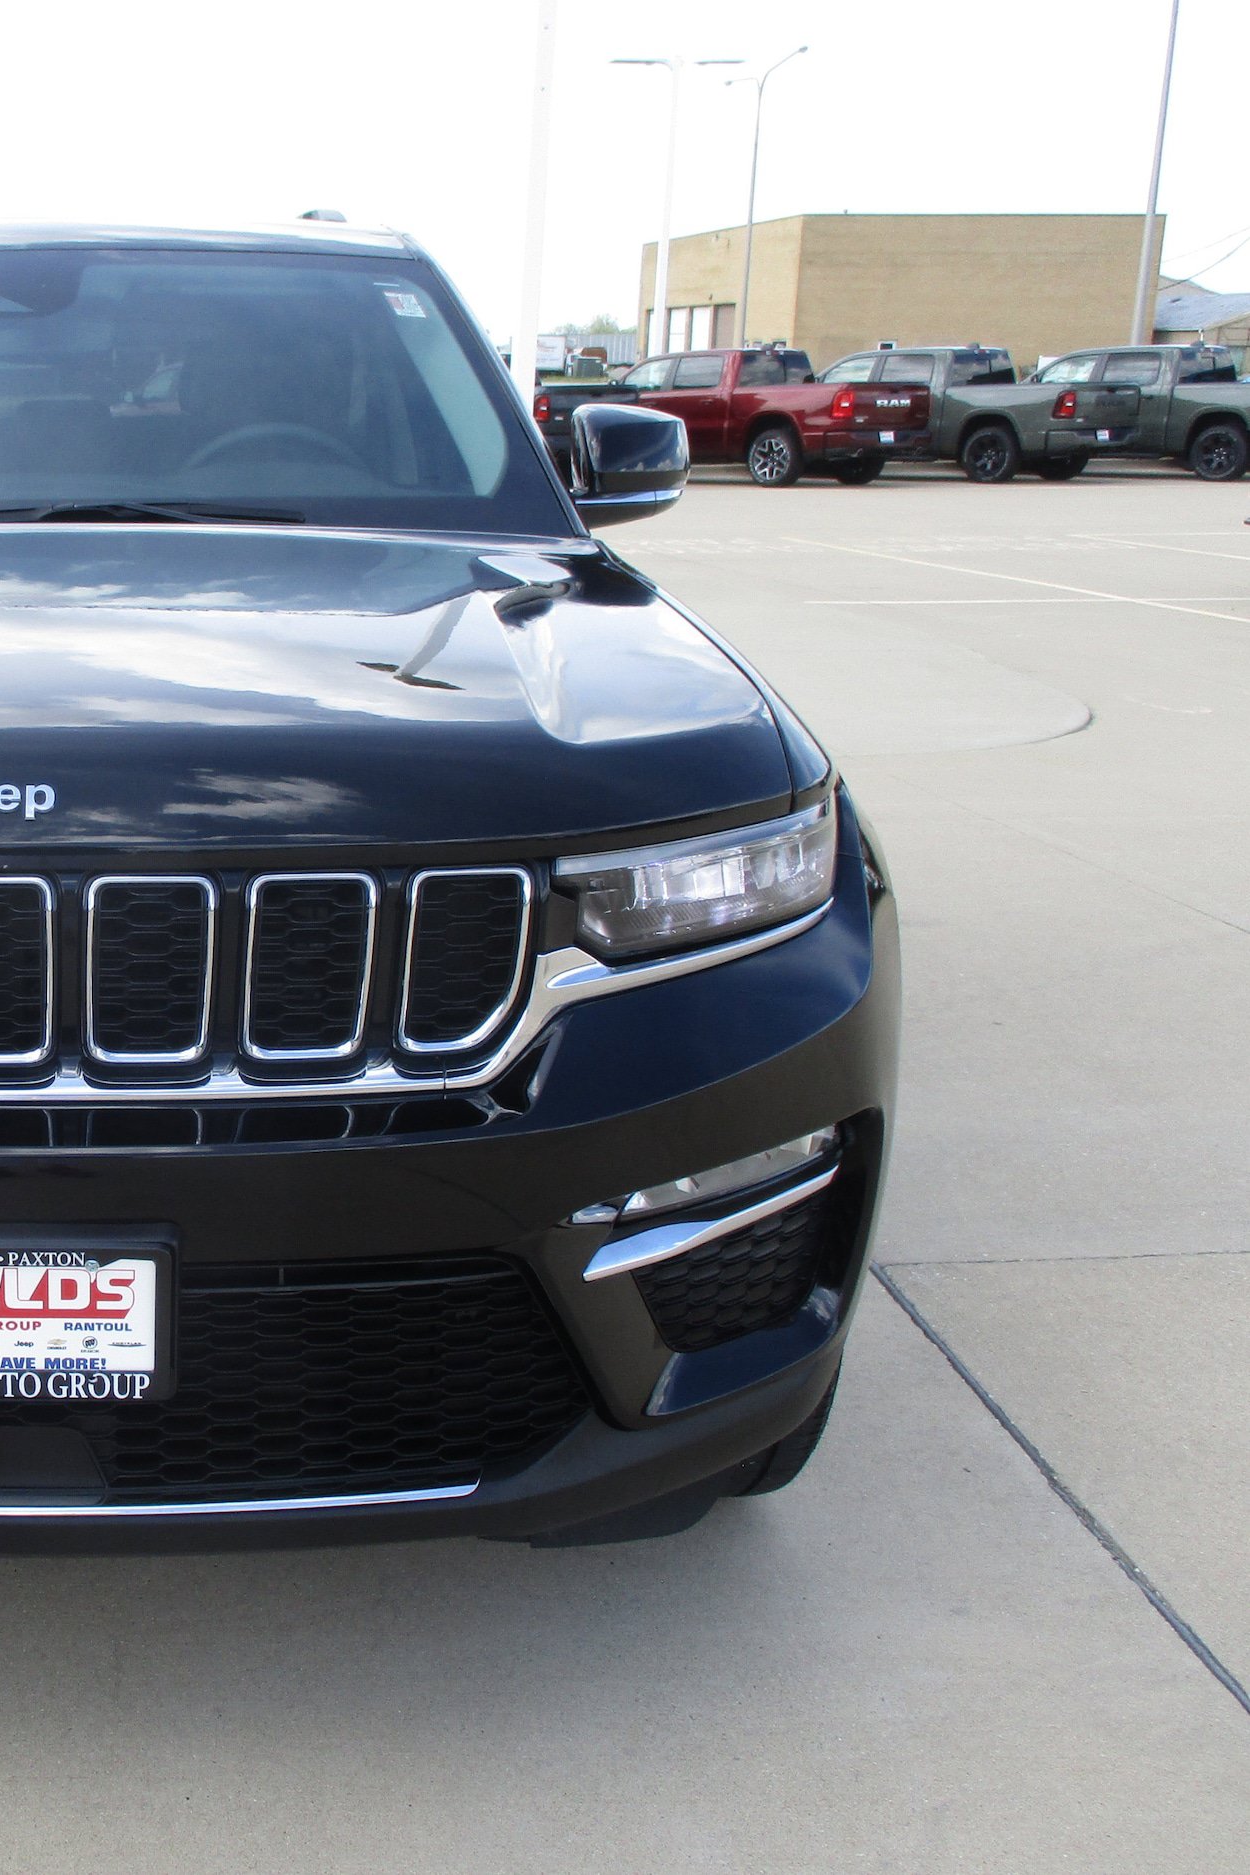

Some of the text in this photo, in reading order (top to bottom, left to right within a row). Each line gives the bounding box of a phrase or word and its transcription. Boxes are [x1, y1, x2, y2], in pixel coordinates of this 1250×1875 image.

[875, 399, 911, 408] RAM
[7, 1251, 86, 1267] PAXTON
[63, 1322, 133, 1332] RANTOUL
[14, 1340, 34, 1348] Jeep
[44, 1357, 107, 1370] MORE!
[47, 1372, 151, 1399] GROUP
